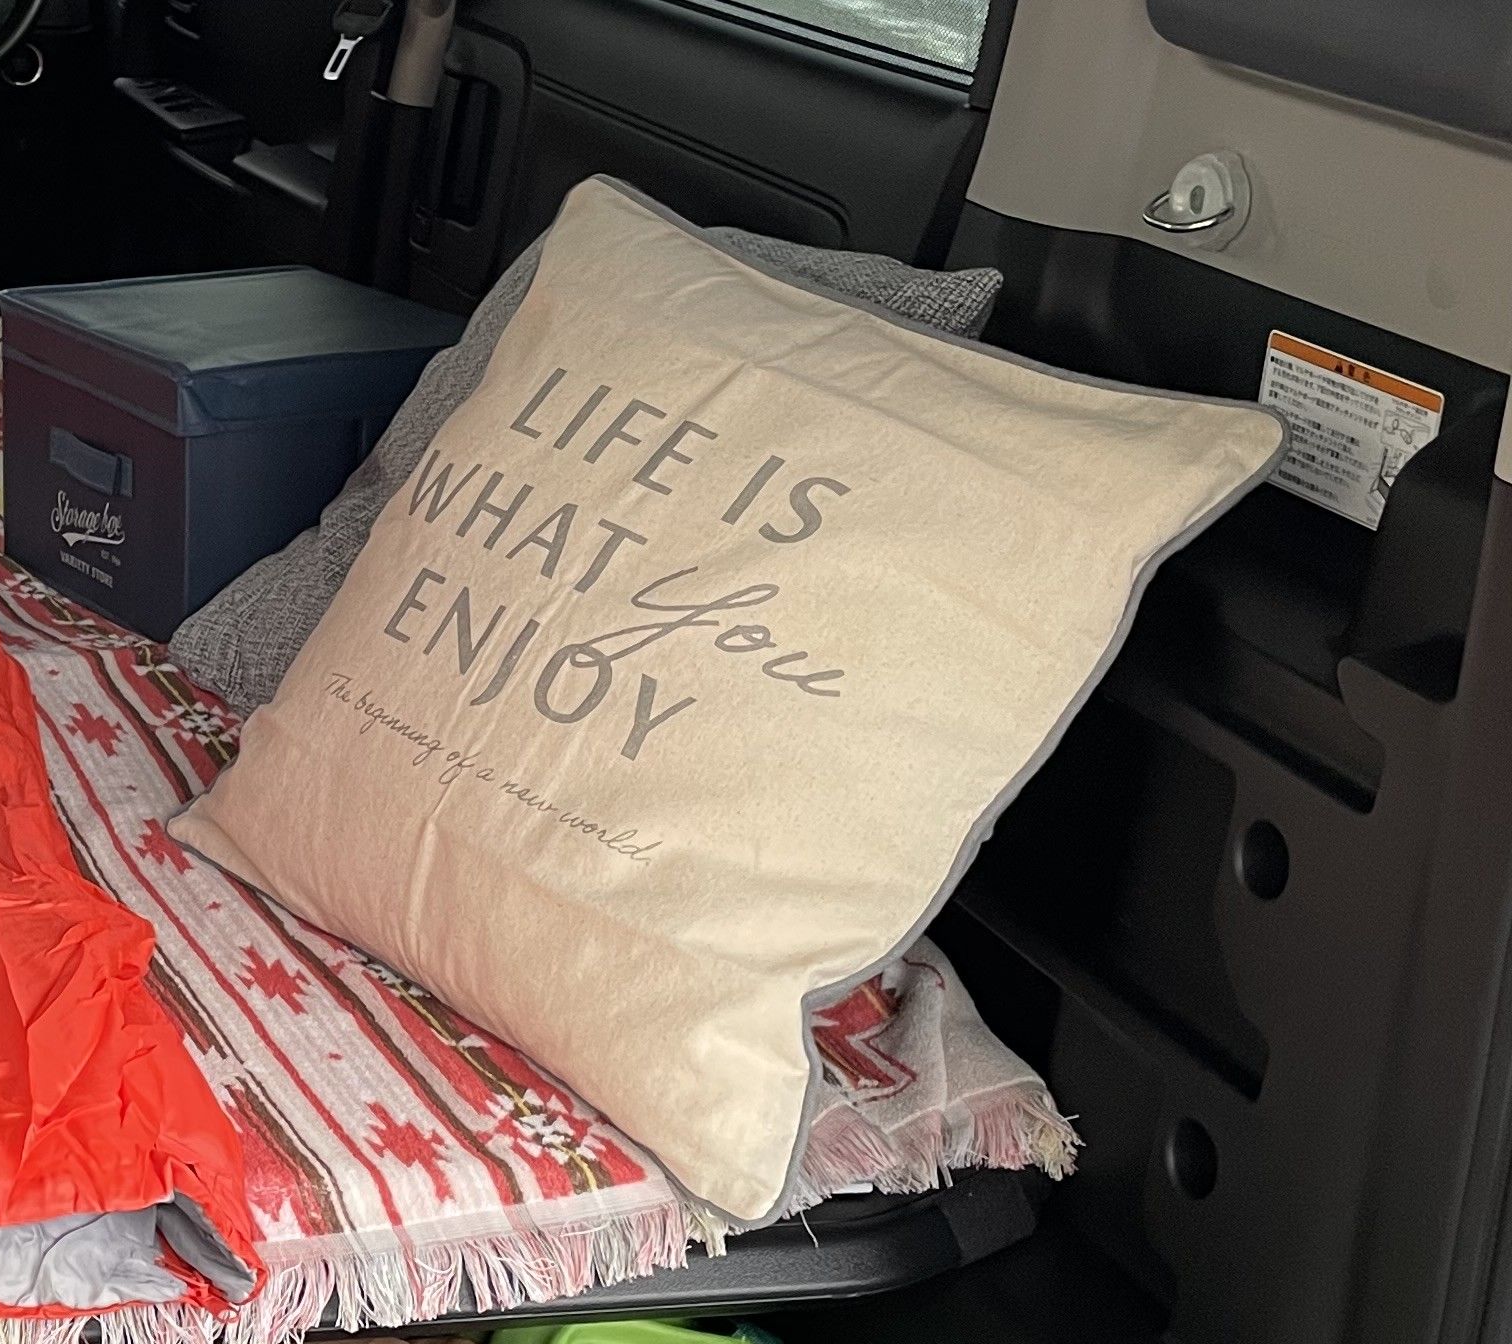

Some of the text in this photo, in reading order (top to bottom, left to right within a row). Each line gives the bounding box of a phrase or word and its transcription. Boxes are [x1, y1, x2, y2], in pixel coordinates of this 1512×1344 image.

[510, 367, 851, 544] LIFE IS
[383, 567, 697, 762] ENJOY
[407, 449, 845, 698] WHAT You
[324, 672, 351, 704] The
[353, 691, 446, 767] beginning
[437, 749, 481, 785] of
[475, 766, 496, 782] a
